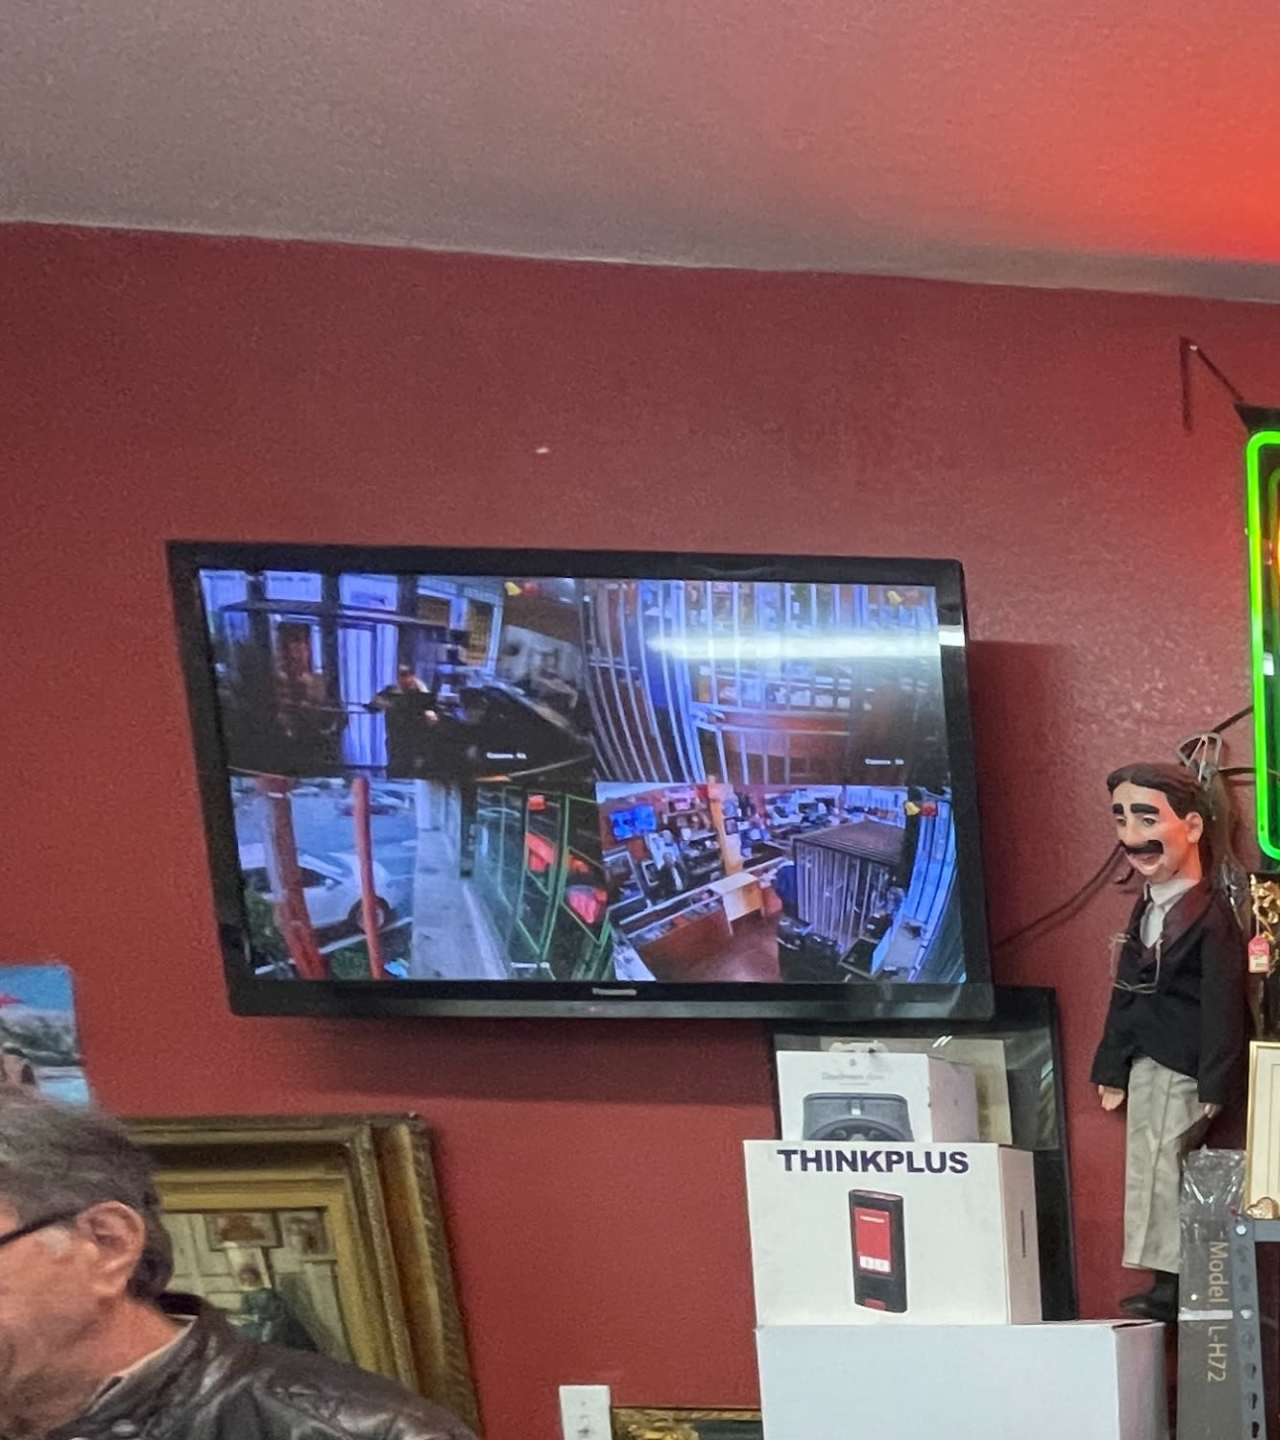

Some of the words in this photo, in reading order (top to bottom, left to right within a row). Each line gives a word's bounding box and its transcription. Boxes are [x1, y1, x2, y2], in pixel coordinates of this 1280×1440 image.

[776, 1149, 969, 1174] THINKPLUS
[1208, 1241, 1229, 1303] Model
[1207, 1325, 1227, 1383] L-H72
